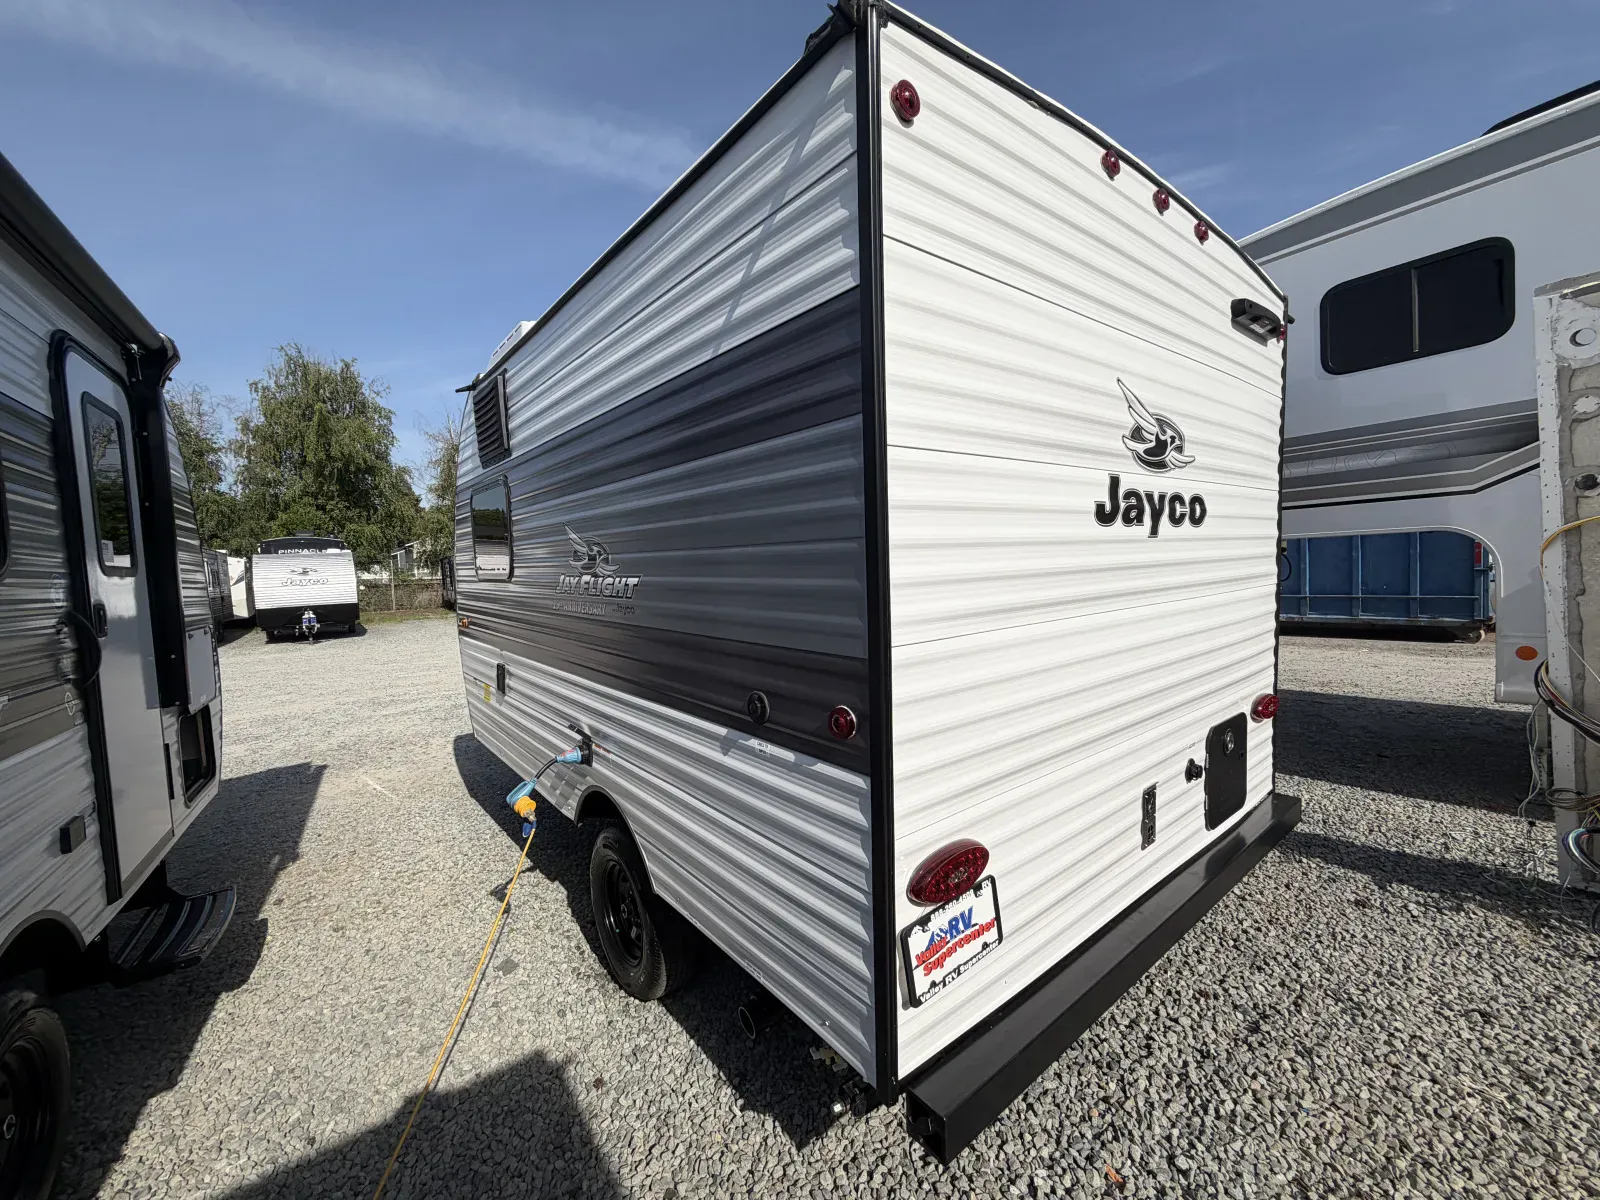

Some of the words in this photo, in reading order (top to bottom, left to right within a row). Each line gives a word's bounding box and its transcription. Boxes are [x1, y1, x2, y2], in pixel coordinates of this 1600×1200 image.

[1094, 473, 1207, 538] Jayco
[281, 577, 329, 586] Jayco
[555, 573, 580, 595] JAY
[579, 574, 640, 598] FLIGHT
[563, 600, 607, 616] ANNIVERSARY
[914, 936, 948, 966] Valley
[947, 905, 974, 941] RV
[922, 916, 997, 977] Supercenter
[919, 980, 944, 1003] Valley
[945, 969, 959, 985] RV
[959, 939, 1000, 973] Supercenter
